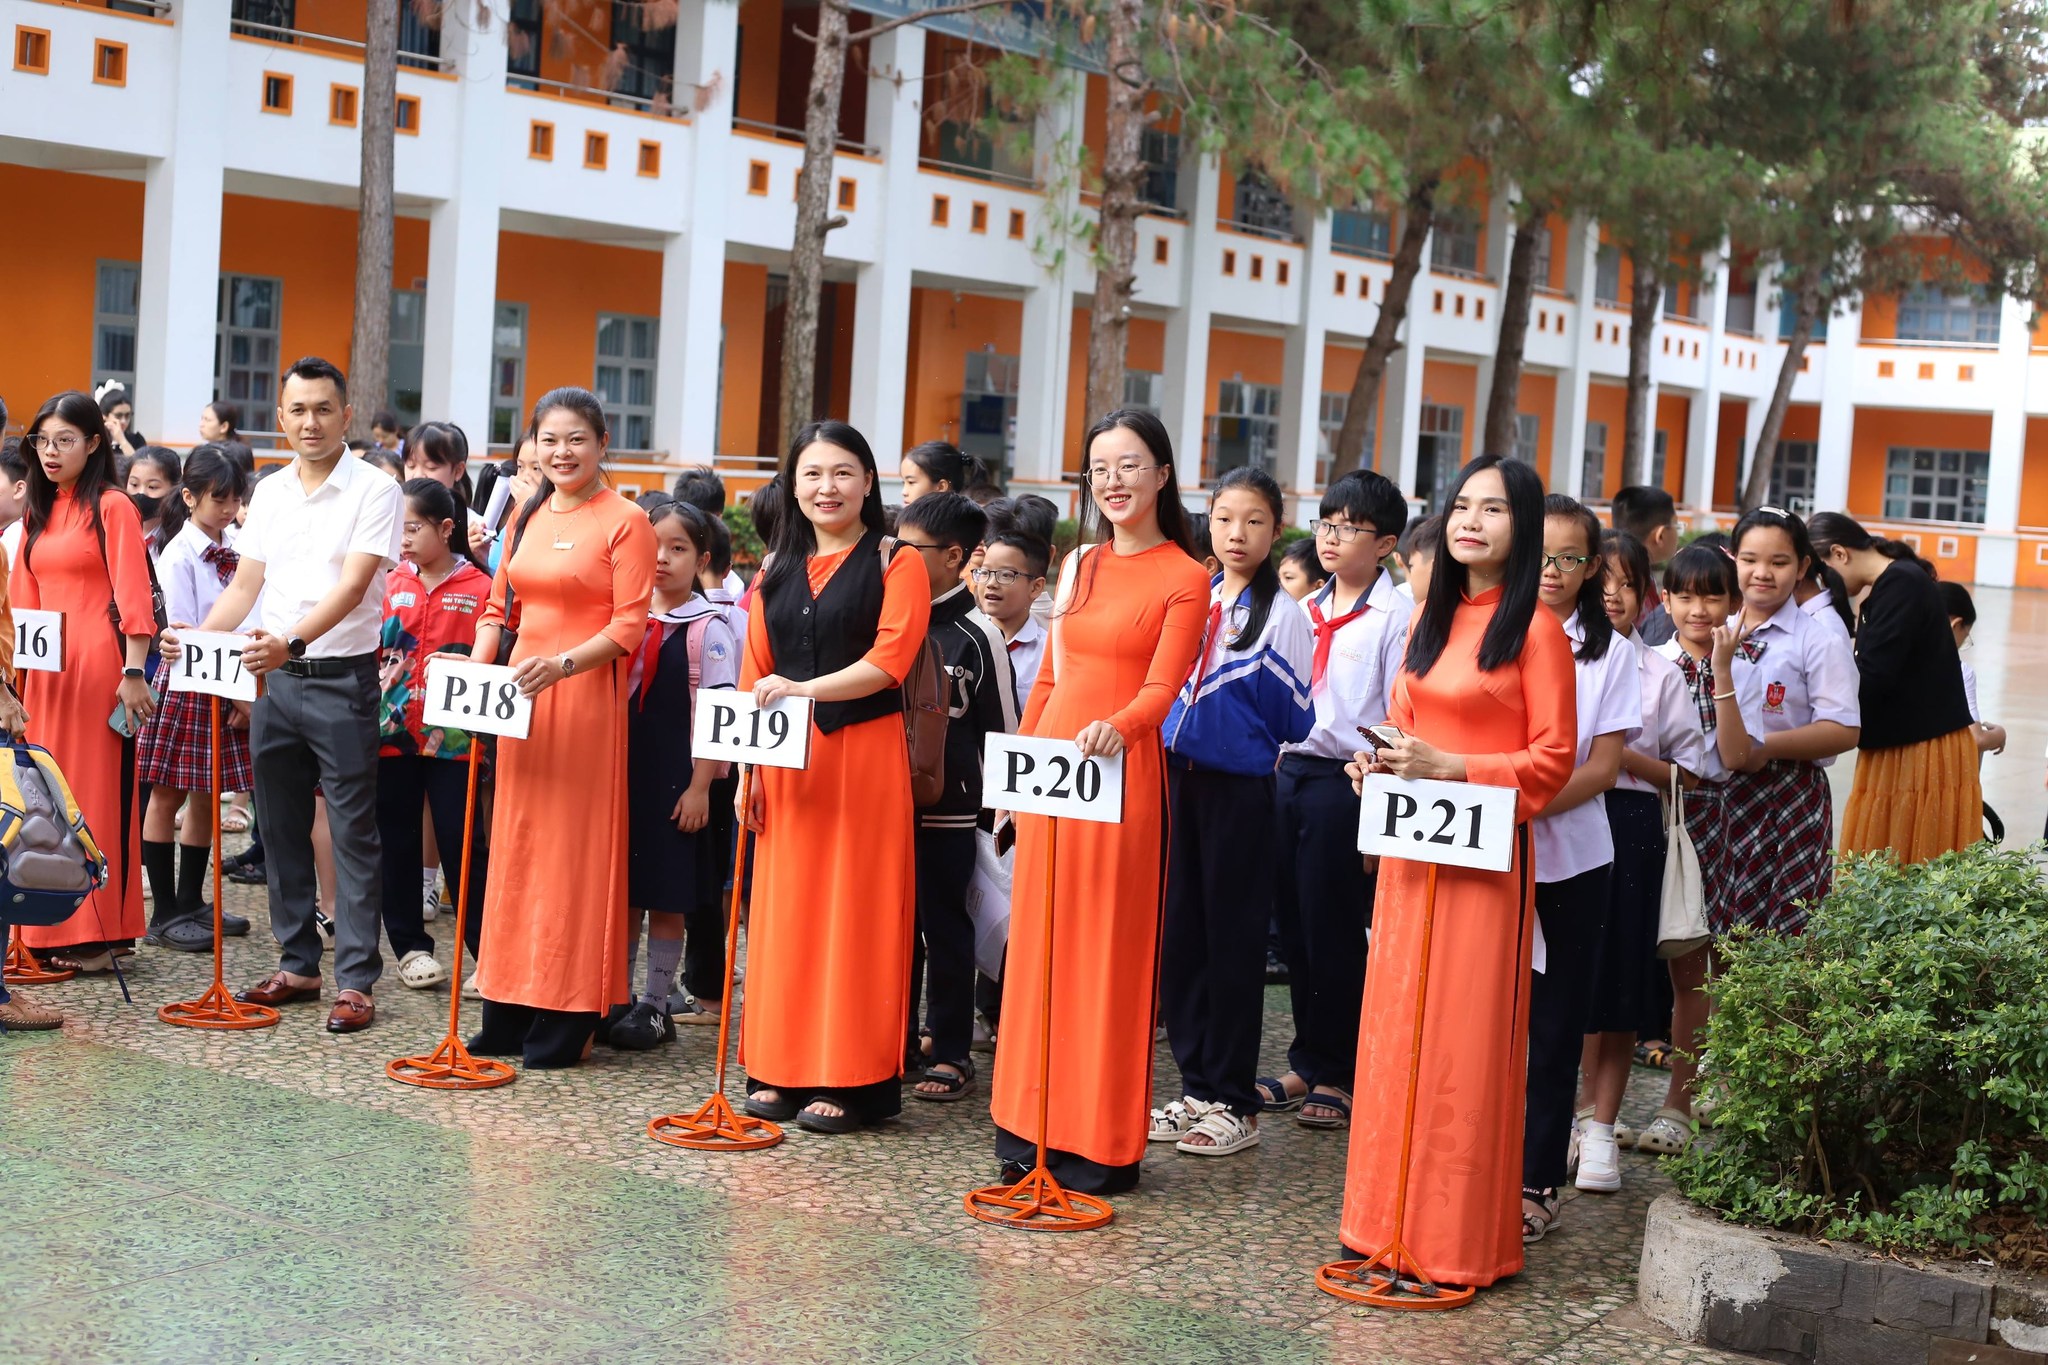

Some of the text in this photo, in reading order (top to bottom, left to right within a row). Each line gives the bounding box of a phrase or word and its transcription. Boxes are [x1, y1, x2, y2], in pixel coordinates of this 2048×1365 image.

[184, 643, 244, 684] P.17
[441, 675, 517, 720] P.18
[709, 705, 789, 750] P.19
[1002, 750, 1101, 802] P.20
[1379, 792, 1485, 850] P.21
